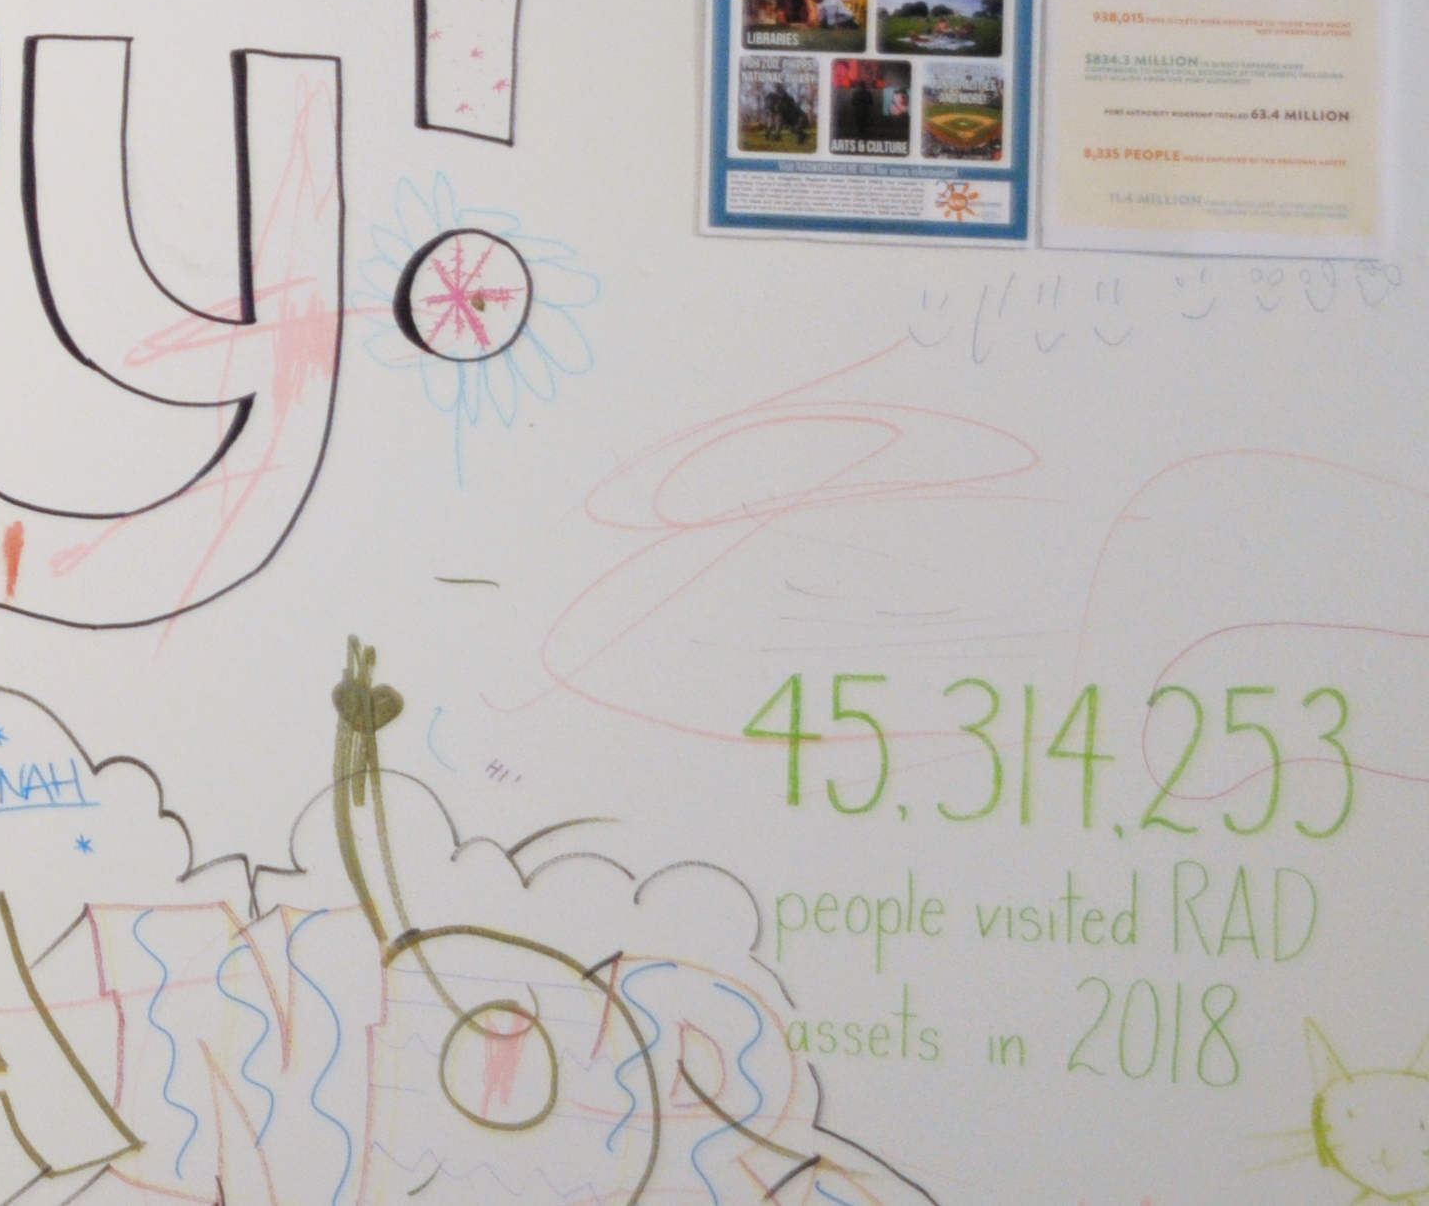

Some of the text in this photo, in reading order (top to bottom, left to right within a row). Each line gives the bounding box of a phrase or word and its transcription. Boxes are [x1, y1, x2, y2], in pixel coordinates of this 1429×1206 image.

[746, 31, 800, 47] LIBRARIES
[1134, 55, 1199, 67] MILLION
[1250, 108, 1280, 121] 63.4
[1283, 110, 1351, 122] MILLION
[830, 139, 857, 153] ARTS
[866, 140, 908, 155] CULTURE
[1124, 148, 1181, 162] PEOPLE
[741, 672, 1355, 840] 45,314,253
[773, 859, 1319, 974] people visited RAD
[784, 975, 1241, 1088] assets in 2018
